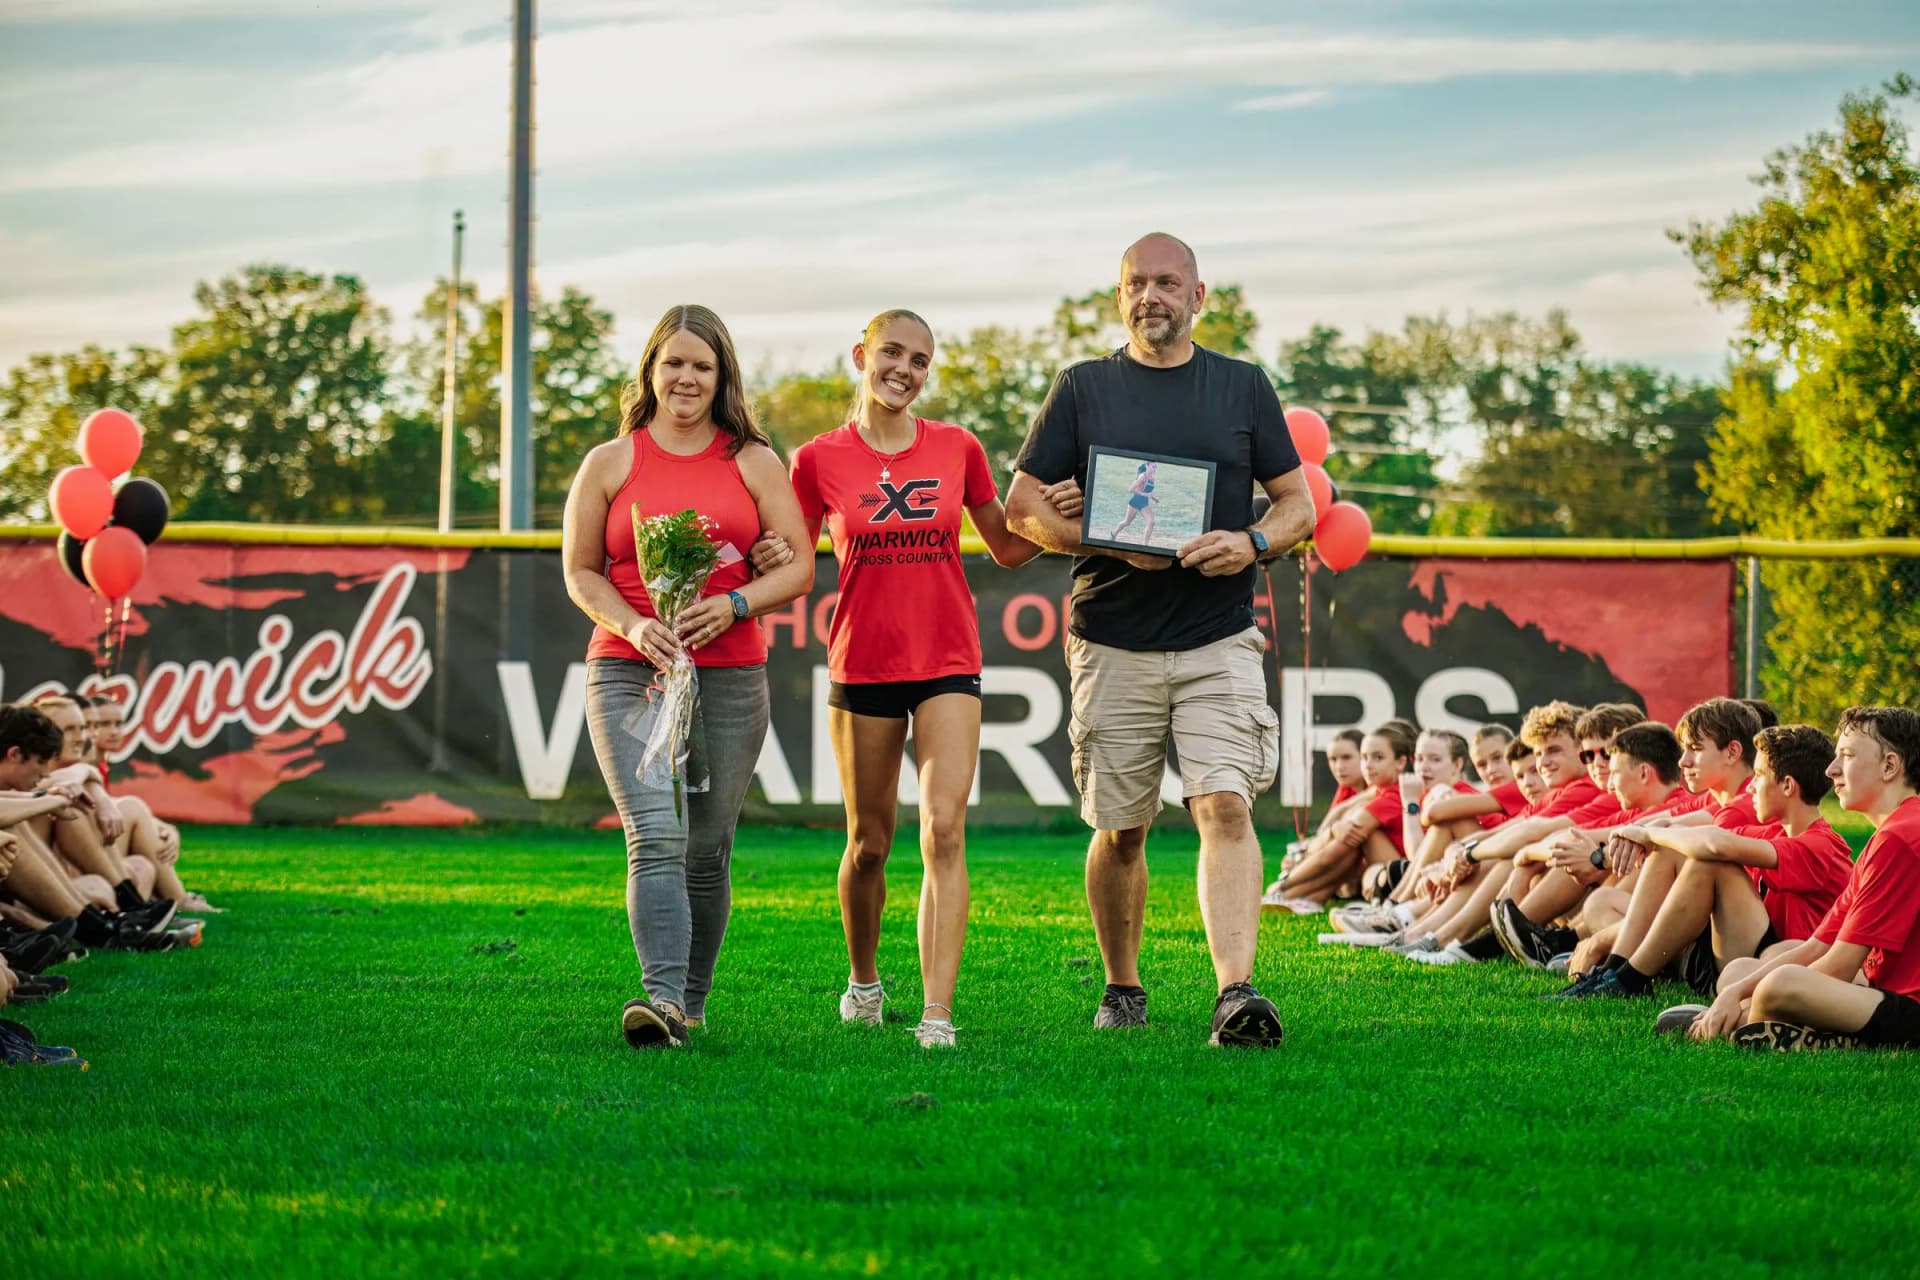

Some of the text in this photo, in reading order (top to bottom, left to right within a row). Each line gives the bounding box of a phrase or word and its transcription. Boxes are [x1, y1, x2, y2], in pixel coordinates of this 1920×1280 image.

[852, 529, 953, 552] WARWICK
[853, 552, 954, 568] CROSS COUNTRY
